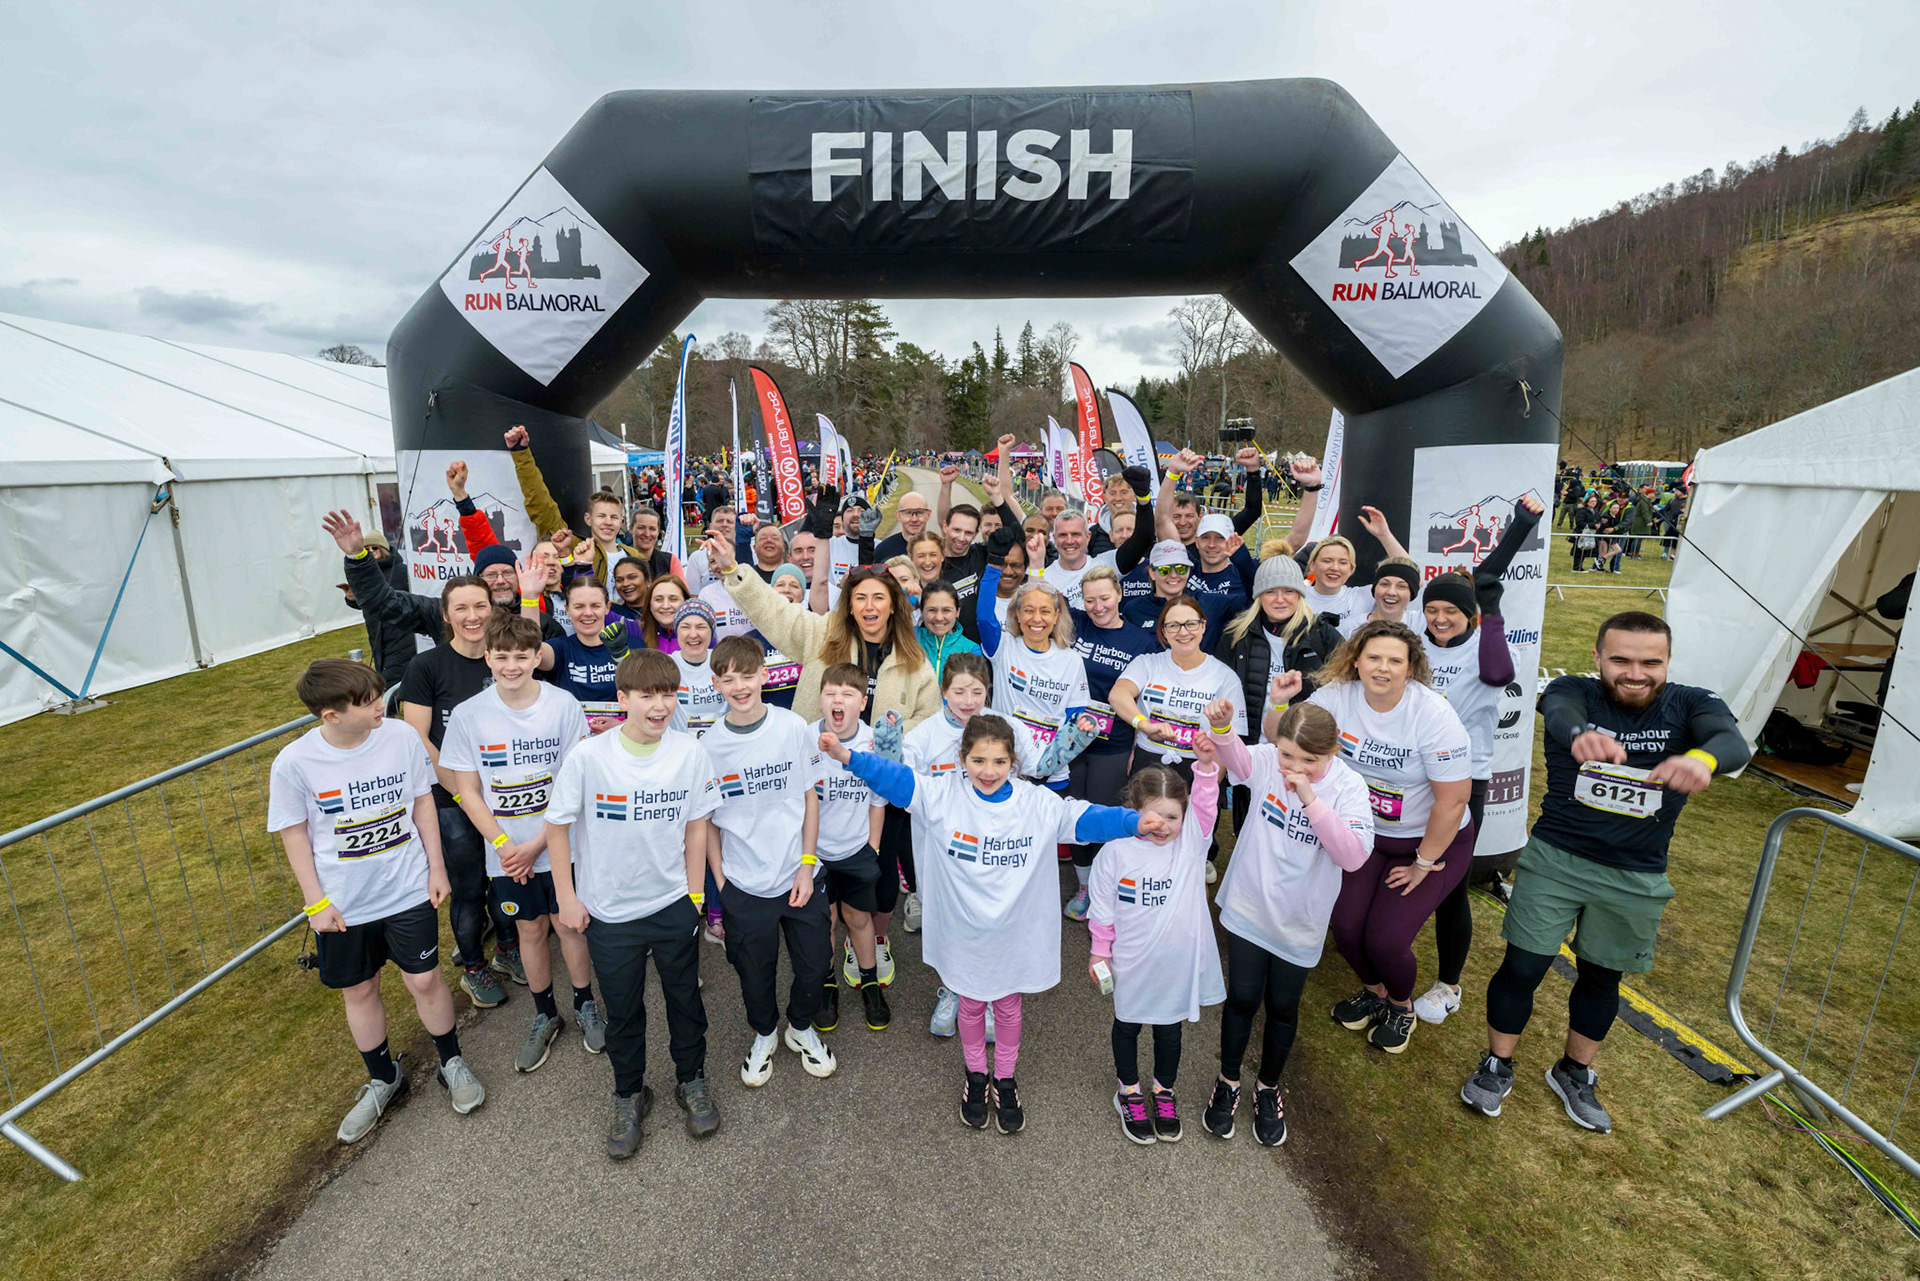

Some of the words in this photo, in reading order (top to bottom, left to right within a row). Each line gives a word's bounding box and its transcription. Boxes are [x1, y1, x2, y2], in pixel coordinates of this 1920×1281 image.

[811, 129, 1133, 201] FINISH
[1332, 282, 1378, 301] RUN
[1381, 280, 1482, 300] BALMORAL
[465, 293, 502, 311] RUN
[506, 293, 605, 312] BALMORAL
[413, 563, 436, 580] RUN
[1123, 581, 1151, 589] Harbou
[1092, 653, 1127, 671] Energy
[1095, 644, 1133, 662] Harbour
[590, 662, 617, 673] Harb
[590, 673, 616, 683] Ener
[1030, 674, 1070, 692] Harbour
[1029, 687, 1064, 706] Energy
[1171, 686, 1216, 701] Harbour
[1168, 696, 1206, 714] Energ
[512, 737, 560, 751] Harbou
[1174, 728, 1192, 743] 44
[1502, 731, 1520, 741] Group
[1362, 738, 1413, 758] Harbour
[1619, 741, 1666, 753] nergy
[513, 751, 559, 765] Energy
[1358, 750, 1404, 769] Energy
[743, 760, 793, 780] Harbour
[747, 776, 788, 795] Energy
[829, 776, 868, 788] Harbo
[351, 788, 403, 810] Energy
[498, 789, 546, 808] 2223
[634, 789, 689, 805] Harbour
[829, 790, 868, 803] Energy
[1591, 782, 1647, 806] 6121
[1370, 795, 1393, 814] 25
[634, 806, 681, 822] Energy
[346, 821, 401, 849] 2224
[983, 836, 1033, 851] Harbour
[982, 851, 1028, 868] Energy
